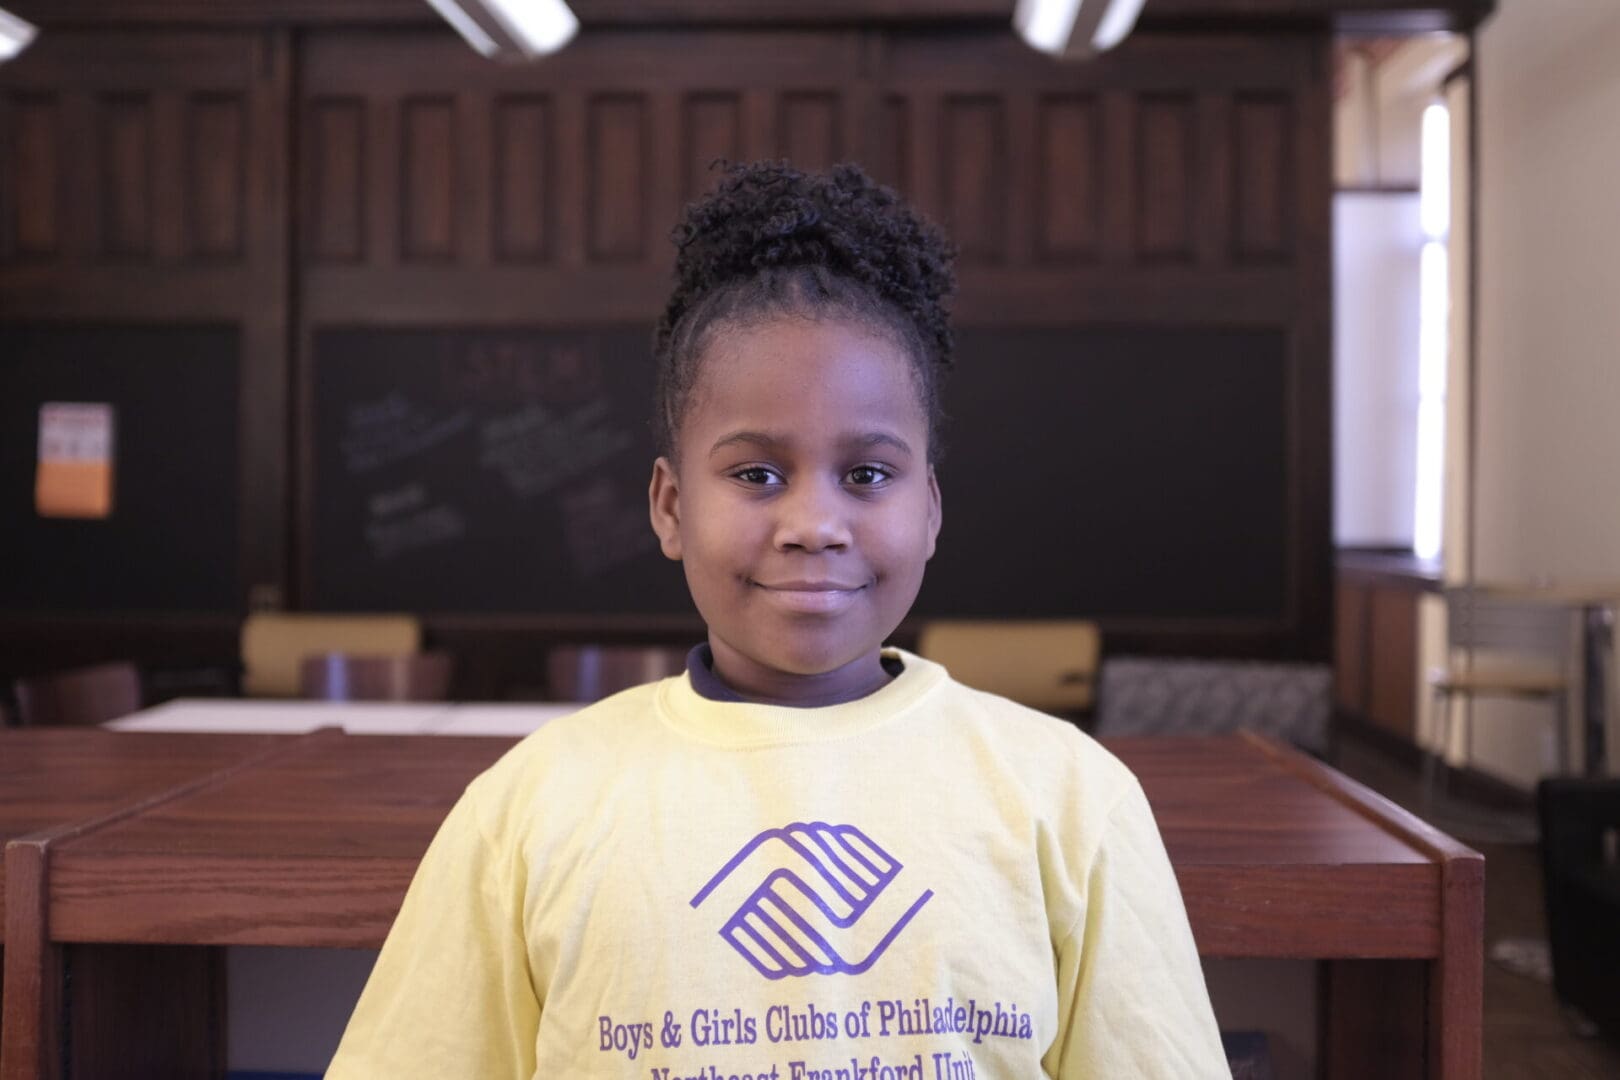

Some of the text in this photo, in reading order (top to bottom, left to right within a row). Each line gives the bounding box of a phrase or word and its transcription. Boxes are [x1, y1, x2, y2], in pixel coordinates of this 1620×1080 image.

[598, 997, 1032, 1060] Boys & Girls Clubs of Philadelphia
[931, 1050, 975, 1080] Unit
